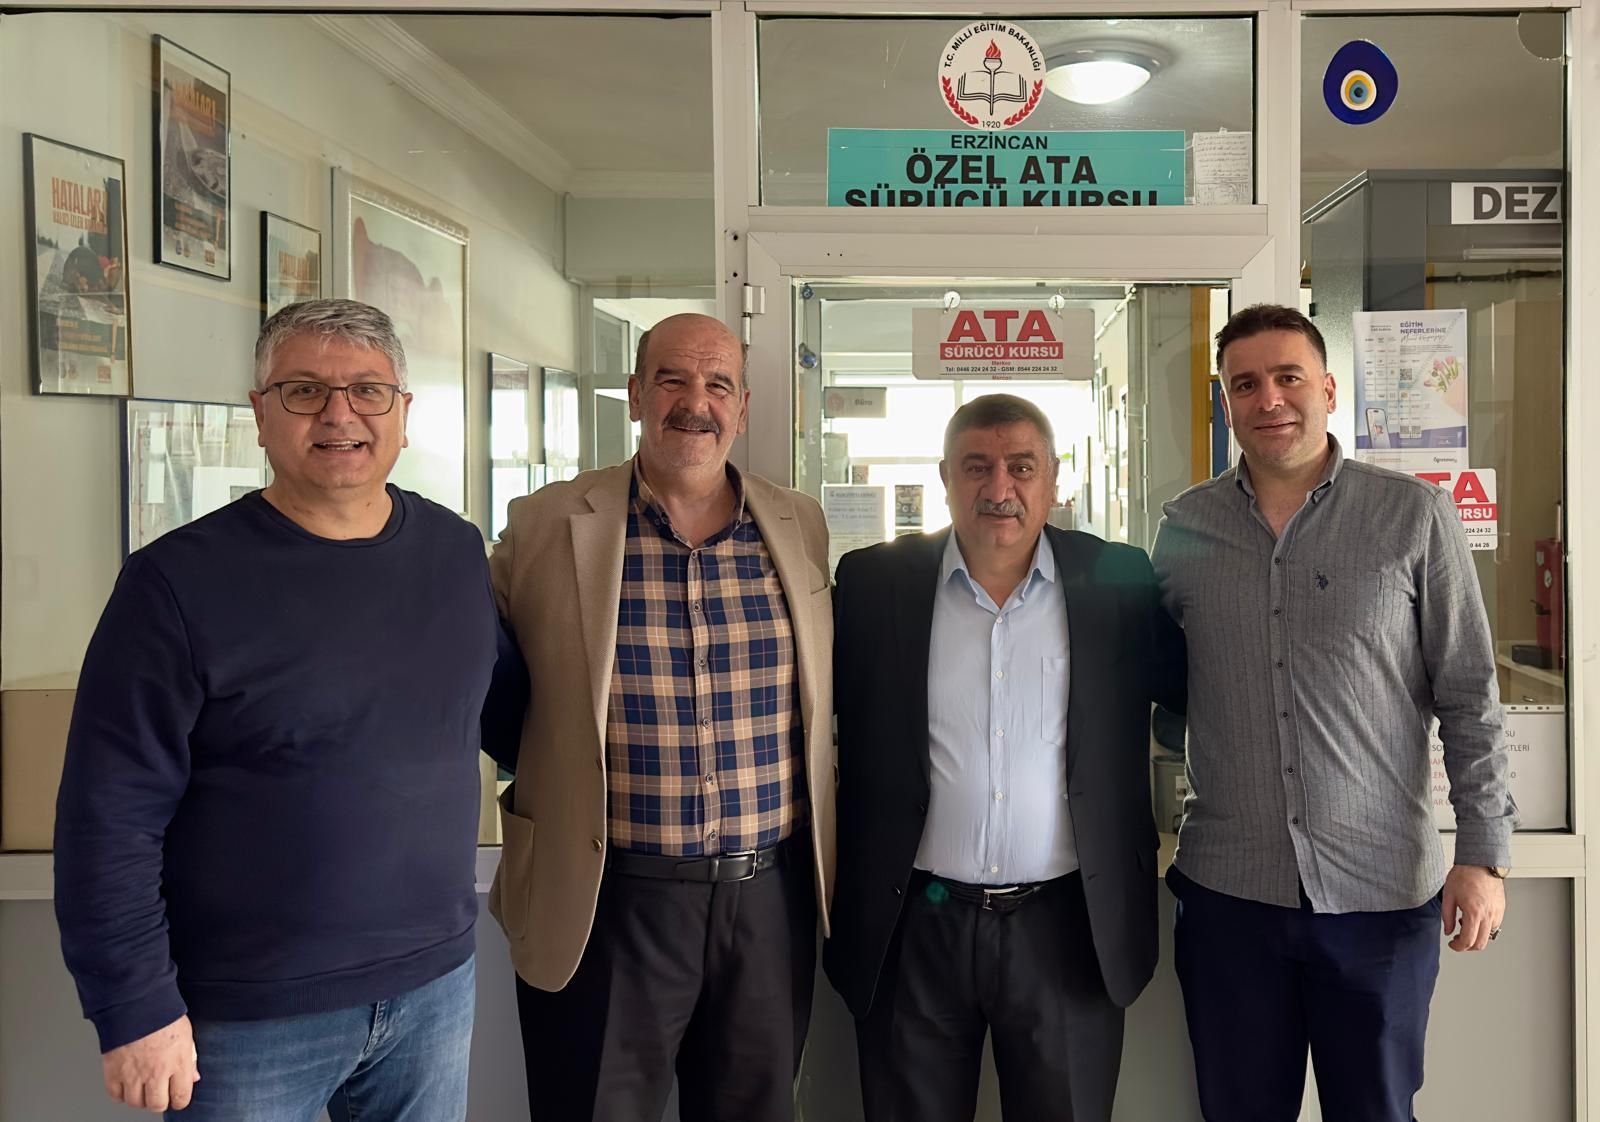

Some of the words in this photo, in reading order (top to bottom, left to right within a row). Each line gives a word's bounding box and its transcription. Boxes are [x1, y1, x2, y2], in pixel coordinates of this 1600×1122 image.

[944, 53, 955, 68] T.C.
[951, 28, 973, 51] MİLLİ
[973, 21, 1006, 34] EĞİTİM
[1008, 28, 1041, 72] BAKANLIĞI
[982, 120, 1001, 129] 1920
[951, 131, 1048, 150] ERZİNCAN
[906, 147, 1007, 185] ÖZEL
[1019, 155, 1098, 185] ATA
[947, 309, 1057, 342] ATA
[1400, 320, 1423, 328] EĞİTİM
[1400, 327, 1447, 335] NEFERLERİNE
[944, 344, 1005, 358] SÜRÜCÜ
[1009, 346, 1059, 358] KURSU
[1508, 744, 1530, 752] TLERİ
